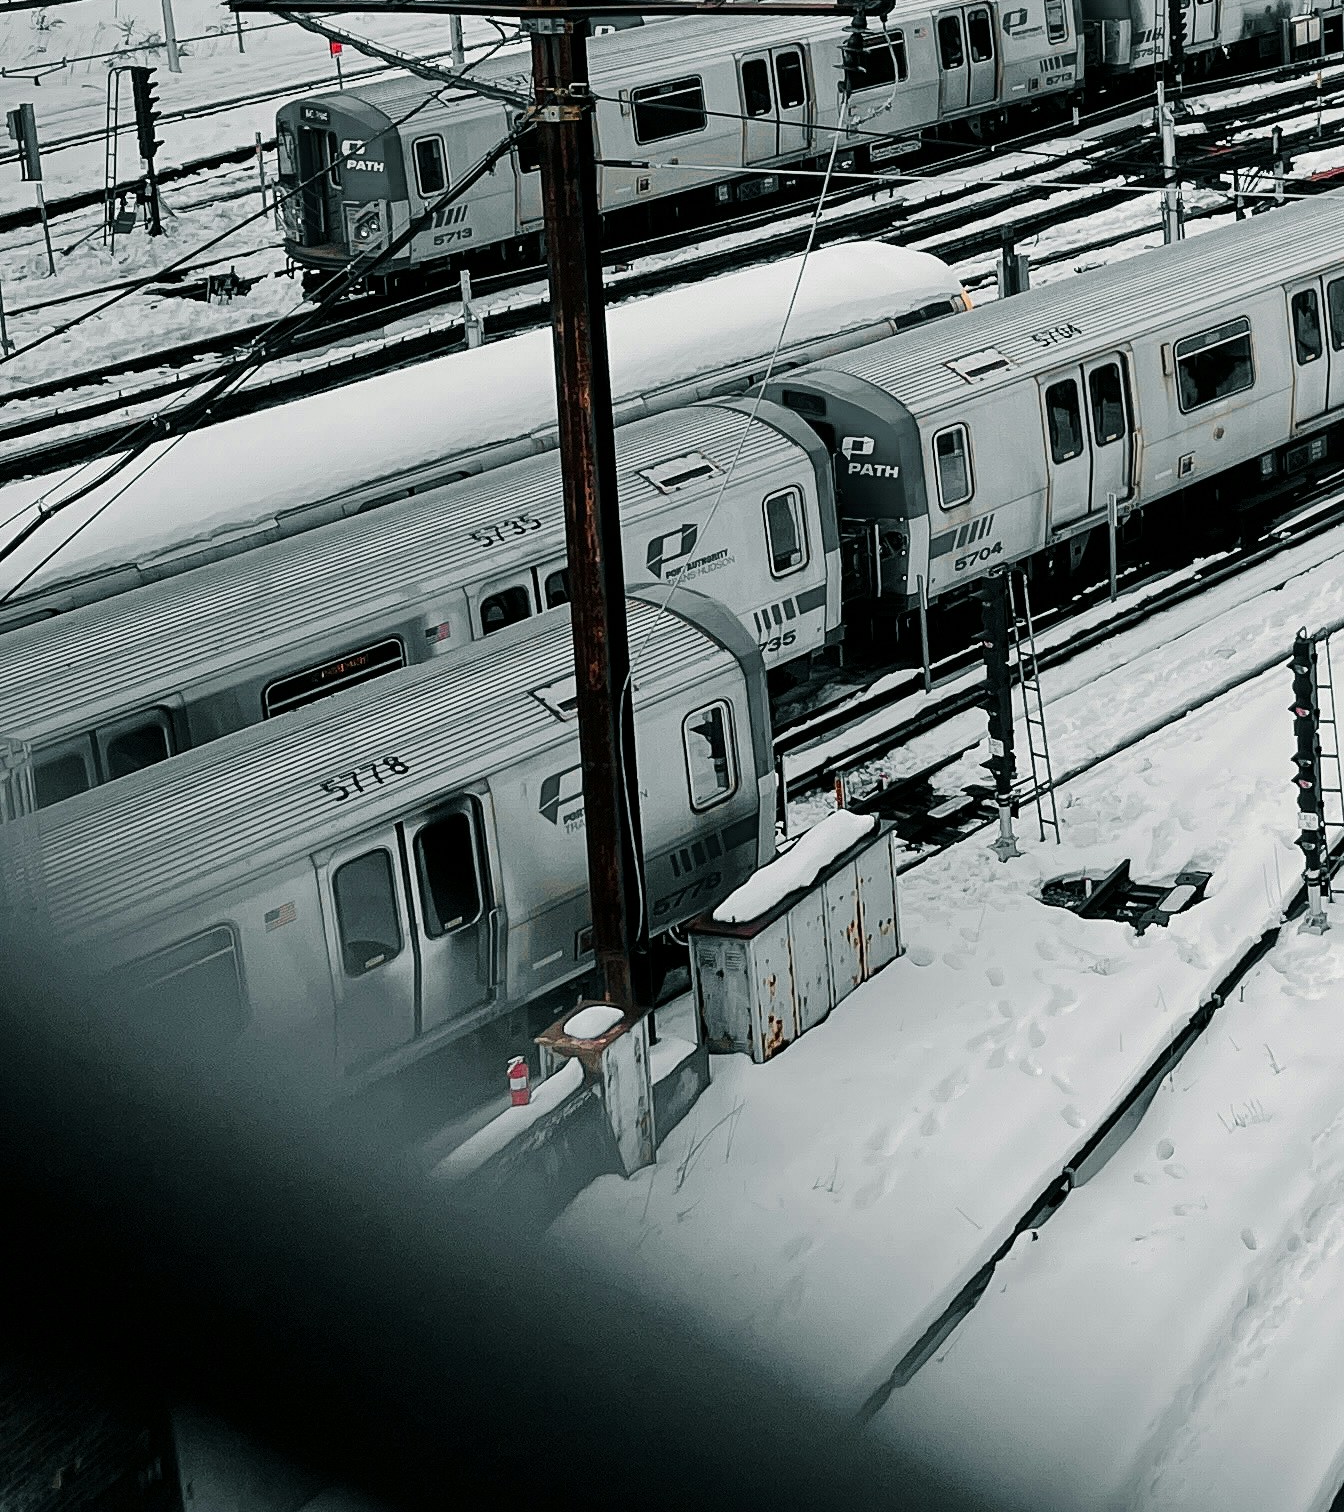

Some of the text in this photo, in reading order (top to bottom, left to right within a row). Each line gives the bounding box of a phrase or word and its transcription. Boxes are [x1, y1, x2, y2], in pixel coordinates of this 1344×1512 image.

[1046, 72, 1073, 85] 5713
[346, 159, 384, 172] PATH
[433, 227, 472, 245] 5713
[848, 462, 899, 478] PATH
[470, 513, 541, 547] 5735
[686, 548, 729, 572] AUTHORITY
[699, 555, 736, 576] HUDSON
[954, 541, 1003, 571] 5704
[758, 629, 796, 652] 735
[320, 756, 409, 801] 5778
[653, 871, 722, 916] 5778
